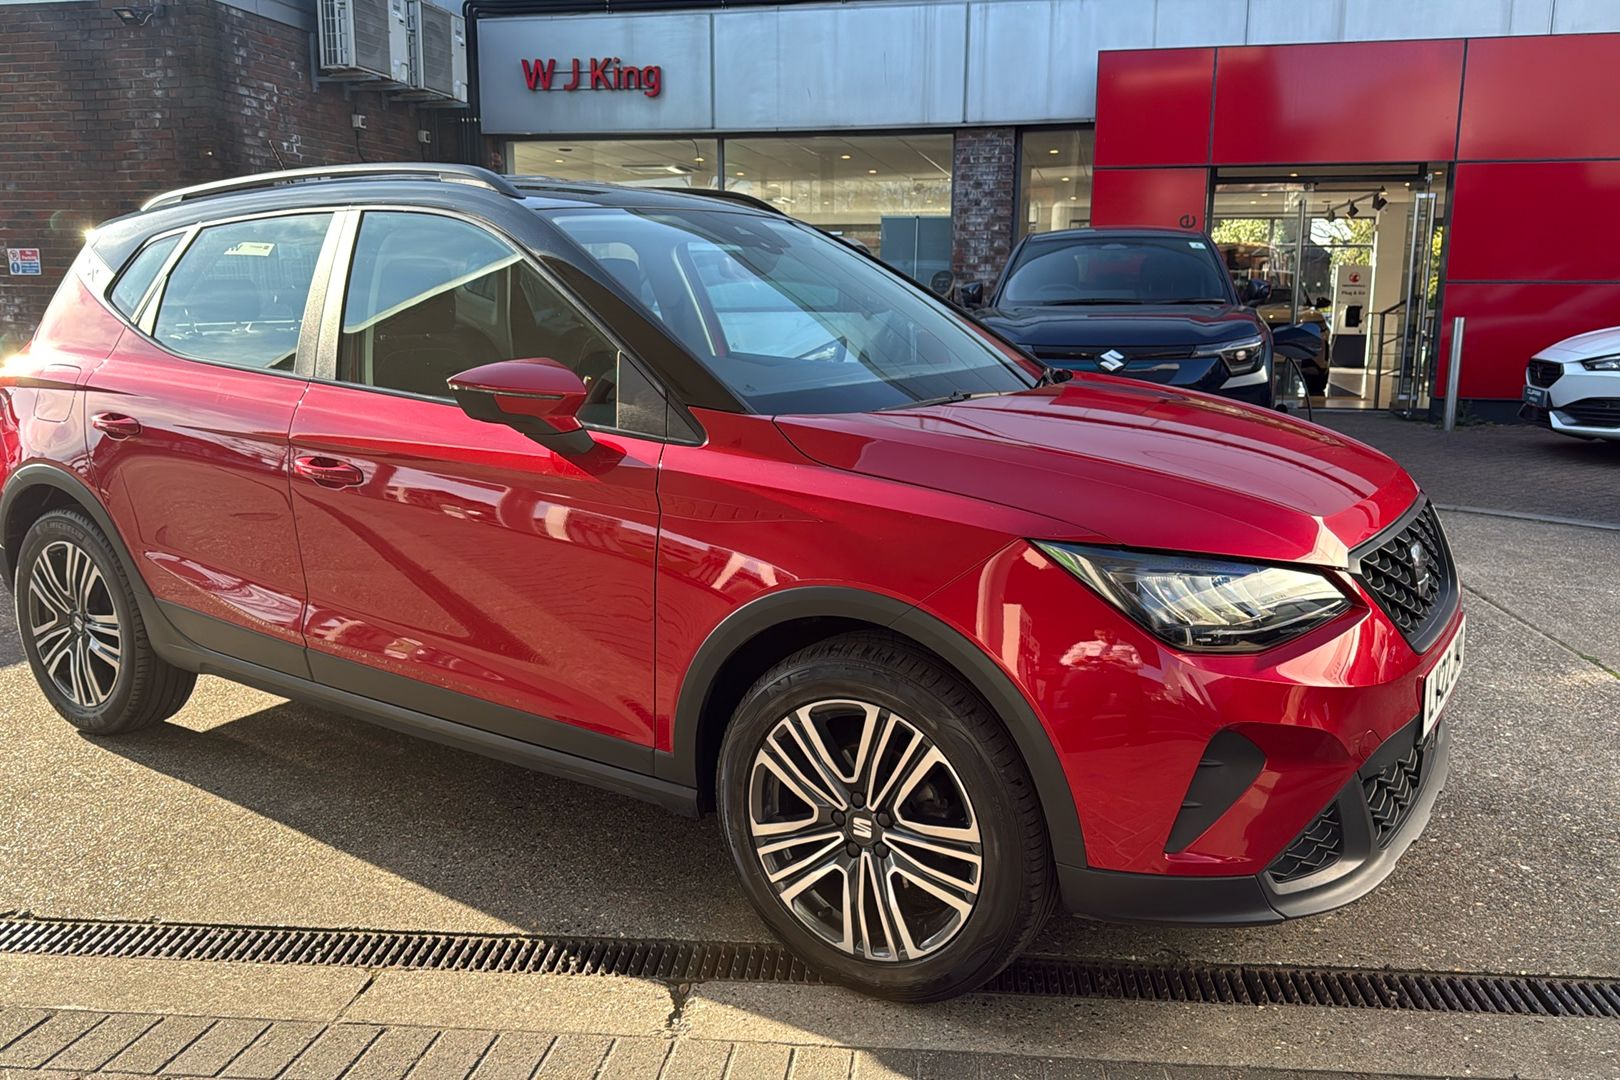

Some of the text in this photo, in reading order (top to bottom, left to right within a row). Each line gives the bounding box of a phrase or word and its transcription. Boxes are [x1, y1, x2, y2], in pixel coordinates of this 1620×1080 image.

[521, 57, 661, 97] W J King
